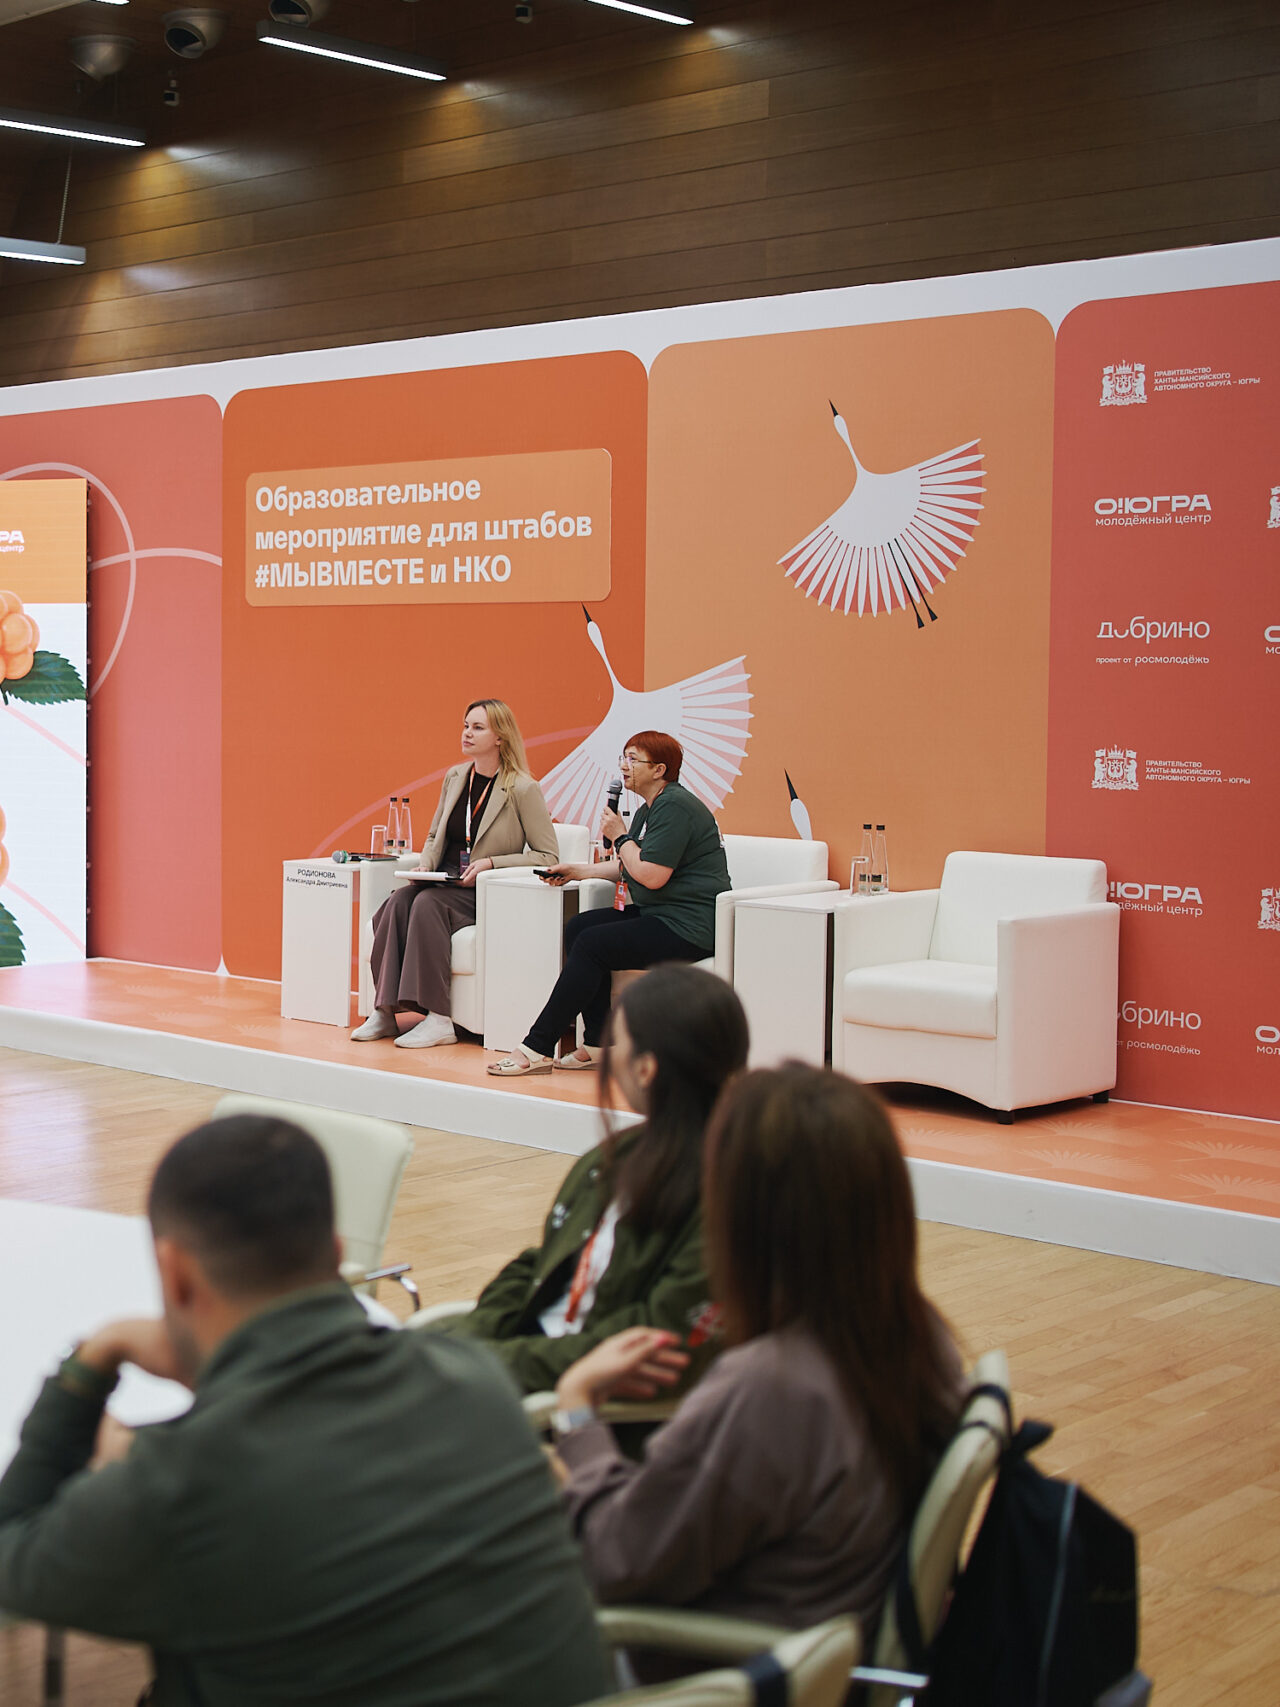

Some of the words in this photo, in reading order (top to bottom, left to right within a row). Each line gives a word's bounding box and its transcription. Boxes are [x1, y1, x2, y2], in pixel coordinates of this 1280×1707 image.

[1153, 366, 1212, 377] ПРАВИТЕЛЬСТВО
[1153, 382, 1205, 392] АВТОНОМНОГО
[1238, 377, 1260, 385] ЮГРЫ
[255, 479, 481, 516] Образовательное
[1094, 493, 1211, 516] О!ЮГРА
[1095, 513, 1173, 528] молодёжный
[1174, 512, 1212, 526] центр
[255, 523, 422, 554] мероприятие
[426, 520, 478, 548] для
[484, 510, 592, 541] штабов
[254, 557, 425, 588] #МЫВМЕСТЕ
[430, 562, 447, 584] и
[452, 554, 512, 584] НКО
[1095, 657, 1122, 665] проект
[1134, 654, 1210, 666] росмолодёжь
[1145, 759, 1203, 768] ПРАВИТЕЛЬСТВО
[1145, 774, 1196, 782] АВТОНОМНОГО
[297, 868, 336, 879] РОДИОНОВА
[1107, 882, 1204, 905] !ЮГРА
[1166, 905, 1204, 918] центр
[1118, 1000, 1202, 1030] брино
[1126, 1040, 1201, 1055] росмолодёжь
